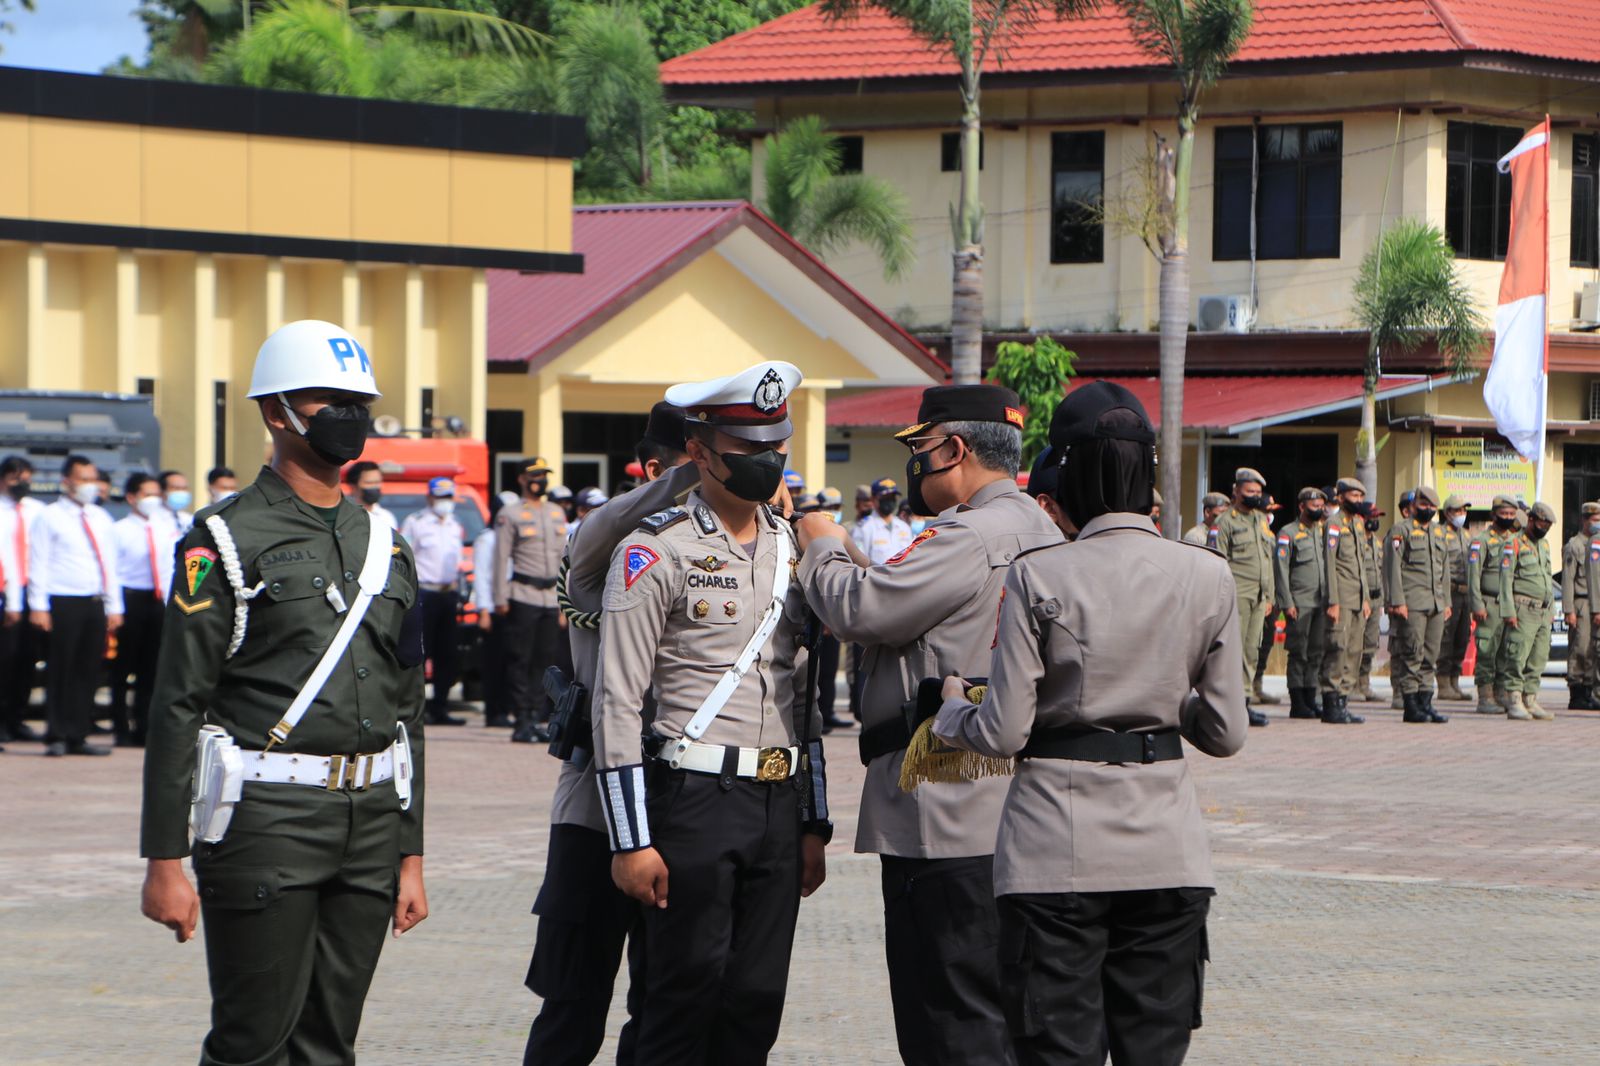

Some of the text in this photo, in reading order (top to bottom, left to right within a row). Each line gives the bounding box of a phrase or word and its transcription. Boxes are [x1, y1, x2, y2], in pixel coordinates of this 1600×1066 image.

[1453, 439, 1482, 447] PELAYANAN
[1500, 472, 1528, 481] BENGKULU
[189, 560, 208, 573] PM
[688, 574, 739, 590] CHARLES
